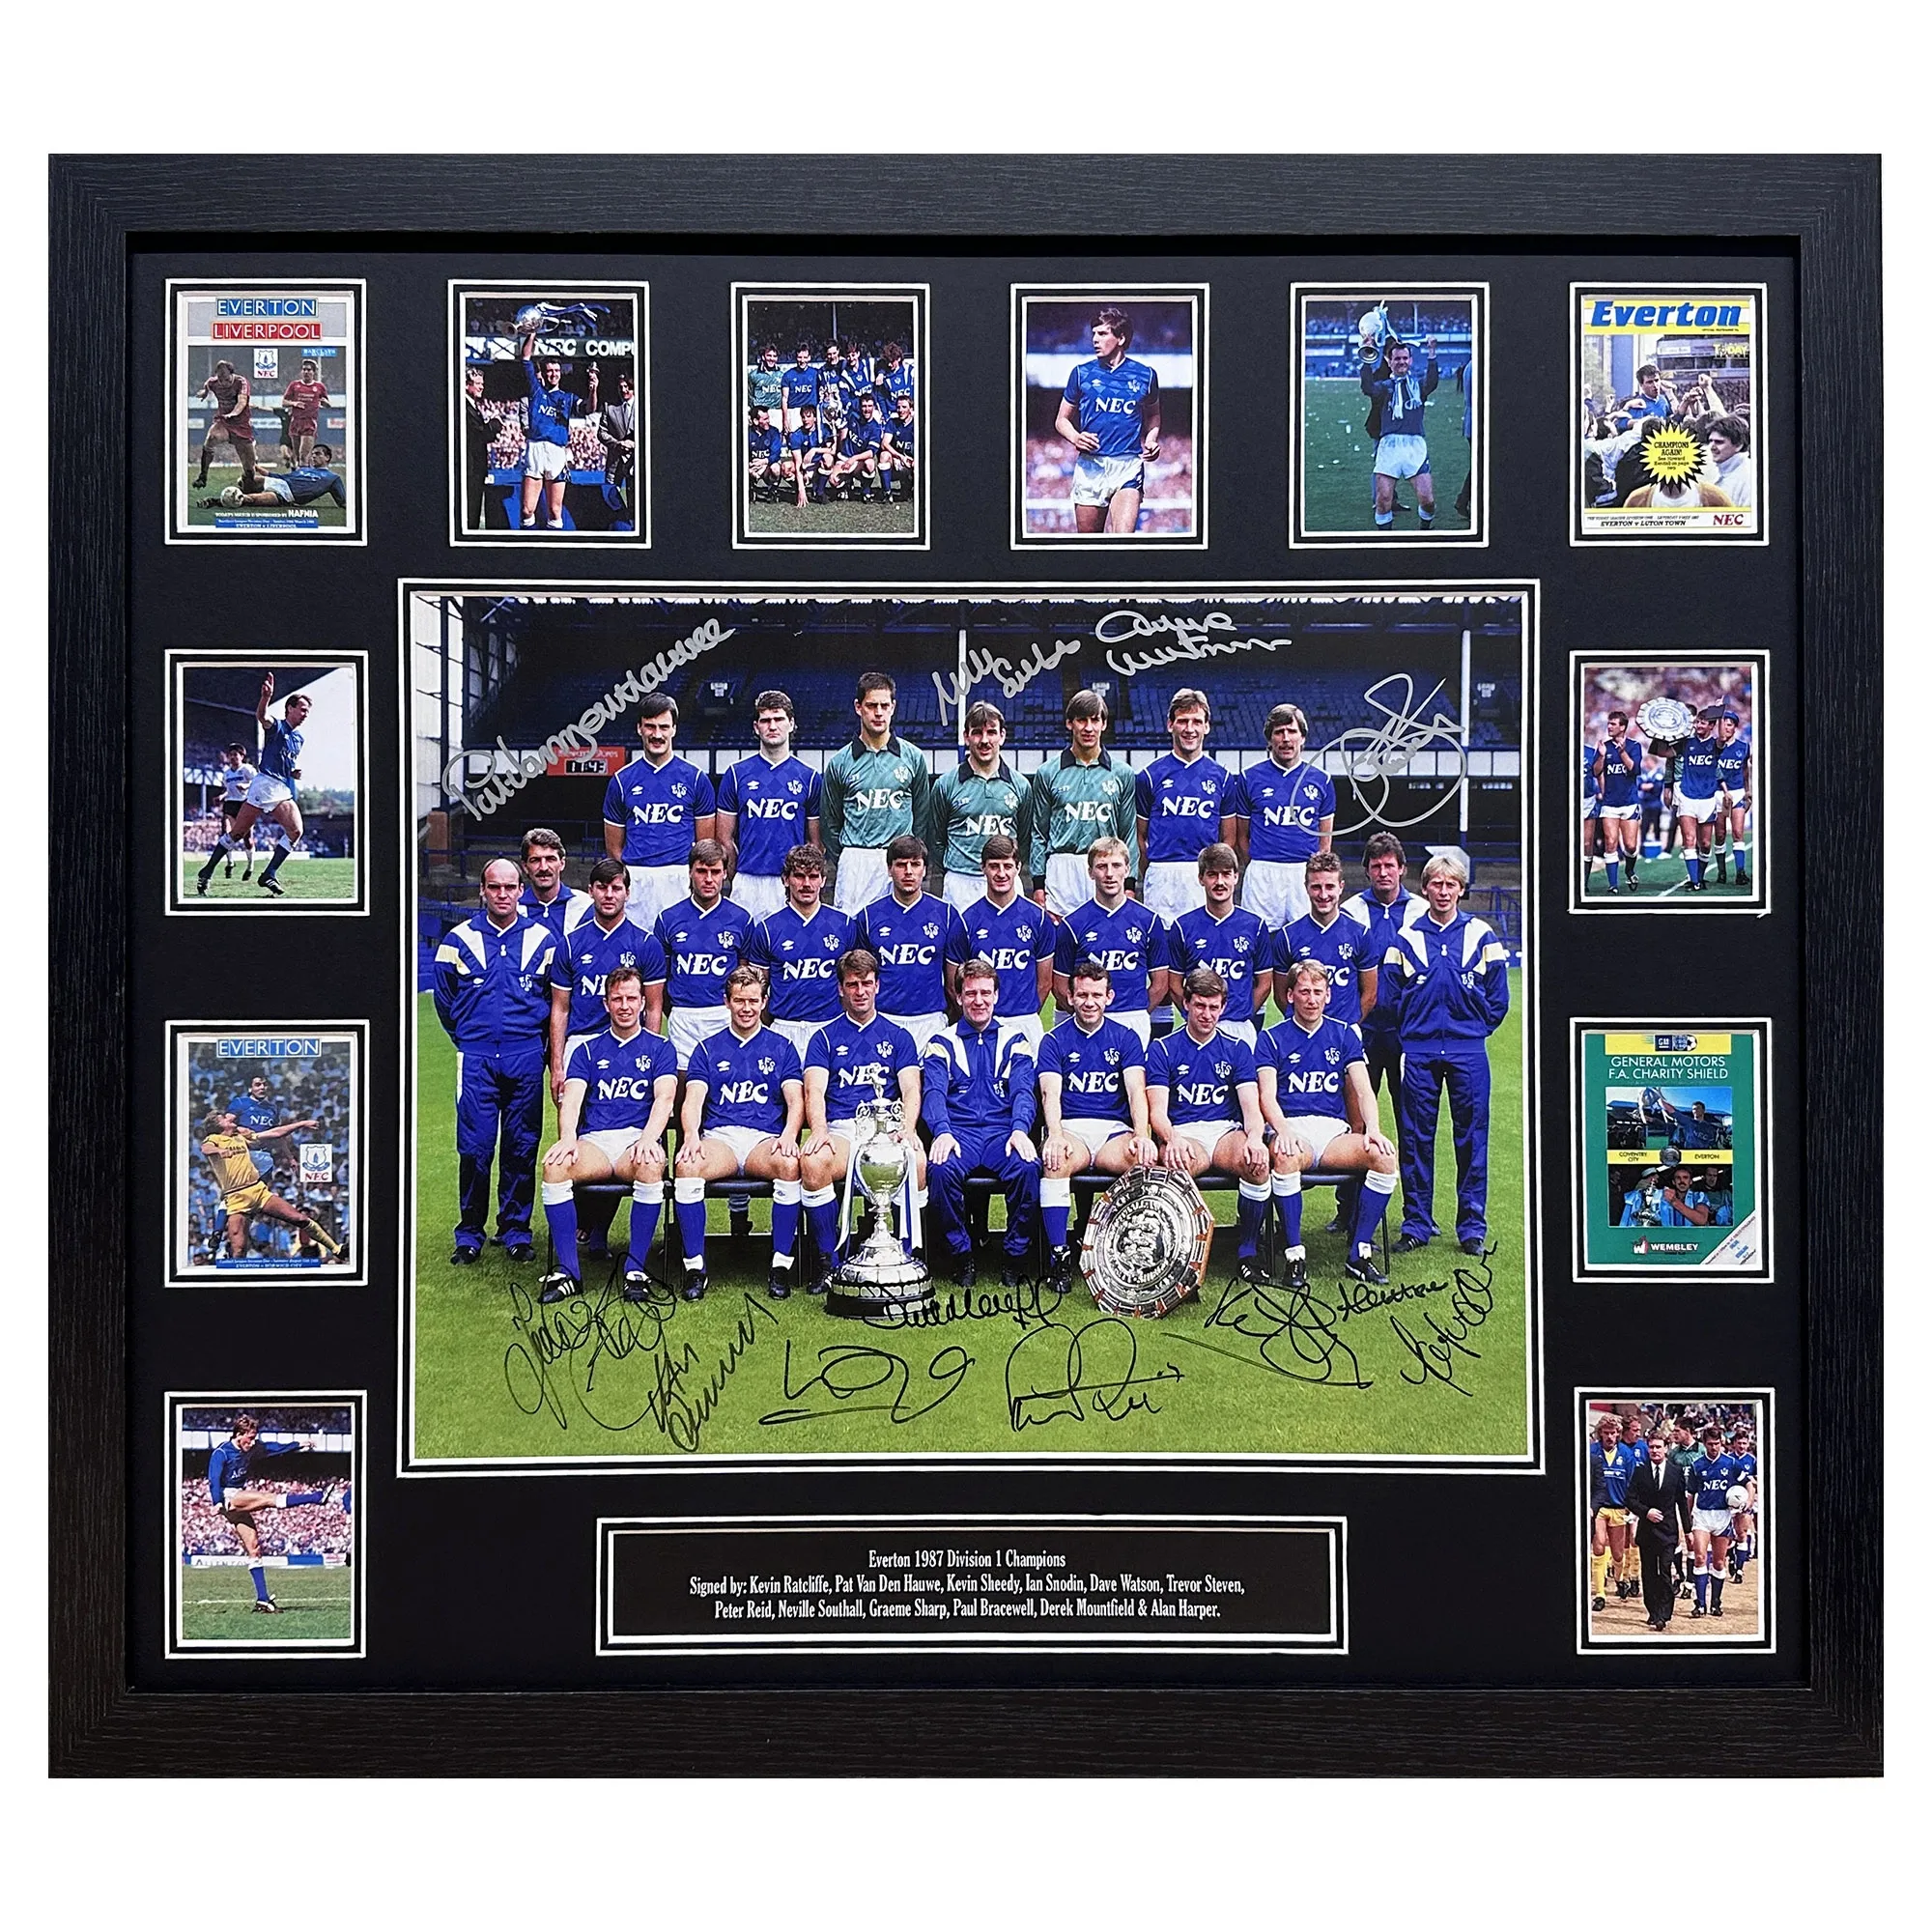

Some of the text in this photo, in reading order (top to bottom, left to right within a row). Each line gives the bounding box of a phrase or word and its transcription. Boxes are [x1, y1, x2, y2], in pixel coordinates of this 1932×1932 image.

[217, 300, 316, 315] EVERTON
[1590, 300, 1742, 327] Everton
[213, 325, 321, 338] LIVERPOOL
[533, 338, 577, 356] NEC
[794, 384, 812, 393] NEC
[1094, 397, 1137, 415] NEC
[1713, 514, 1745, 526] NEC
[1688, 754, 1713, 766] NEC
[1717, 758, 1742, 769] NEC
[746, 799, 798, 820] NEC
[854, 788, 904, 810] NEC
[1161, 796, 1214, 819] NEC
[633, 803, 683, 825] NEC
[1064, 803, 1111, 822] NEC
[1264, 806, 1315, 827] NEC
[966, 814, 1013, 836] NEC
[676, 953, 728, 976] NEC
[878, 944, 936, 965] NEC
[978, 949, 1031, 970] NEC
[1088, 950, 1139, 971] NEC
[782, 958, 836, 980] NEC
[1197, 957, 1245, 980] NEC
[1324, 965, 1350, 986] EC
[218, 1040, 319, 1056] EVERTON
[1610, 1056, 1726, 1067] GENERAL MOTORS
[838, 1062, 890, 1089] NEC
[1067, 1071, 1120, 1094] NEC
[1288, 1071, 1339, 1094] NEC
[1608, 1068, 1729, 1079] F.A. CHARITY SHIELD
[597, 1078, 649, 1100] NEC
[720, 1080, 769, 1105] NEC
[1178, 1083, 1229, 1106] NEC
[304, 1172, 329, 1181] NEC
[1703, 1479, 1728, 1492] NEC
[868, 1548, 1066, 1571] Everton 1987 Division 1 Champions
[689, 1573, 1245, 1598] Signed by: Kevin Ratcliffe, Pat Van Den Hauwe, Kevin Sheedy, Ian Snodin, Dave Watson, Trevor Steven,
[714, 1597, 1221, 1621] Peter Reid, Neville Southall, Graeme Sharp, Paul Bracewell, Derek Mountfield & Alan Harper.
